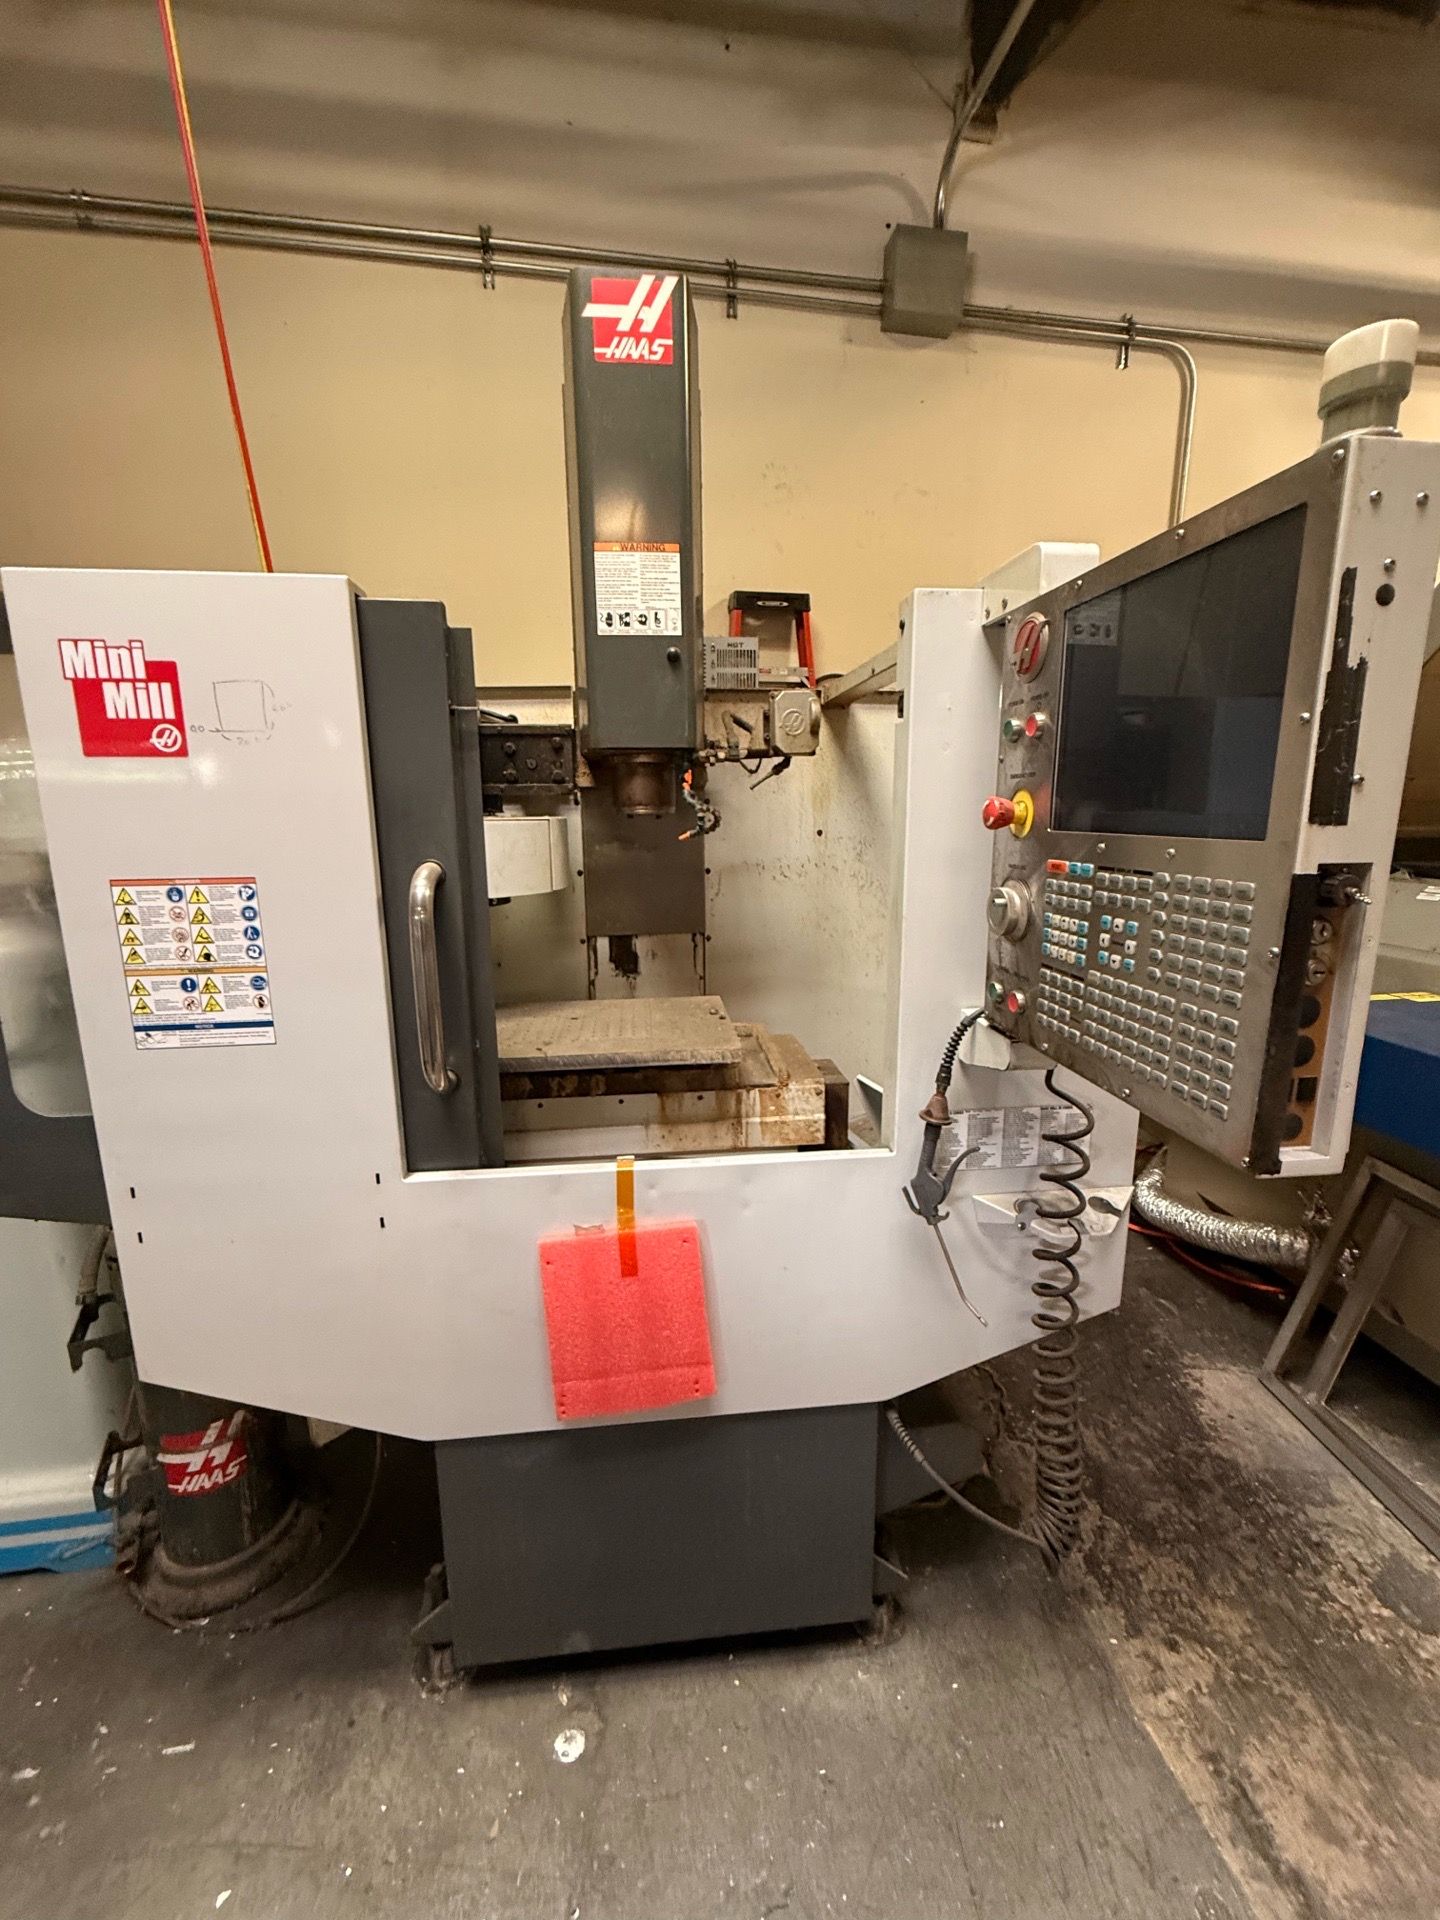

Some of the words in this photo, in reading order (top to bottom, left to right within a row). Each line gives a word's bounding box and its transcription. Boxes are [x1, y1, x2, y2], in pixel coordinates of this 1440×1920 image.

[594, 336, 673, 360] HAAS
[620, 543, 666, 552] WARNING
[60, 640, 147, 679] Mini
[102, 681, 176, 720] Mill
[168, 1455, 247, 1493] HAAS
